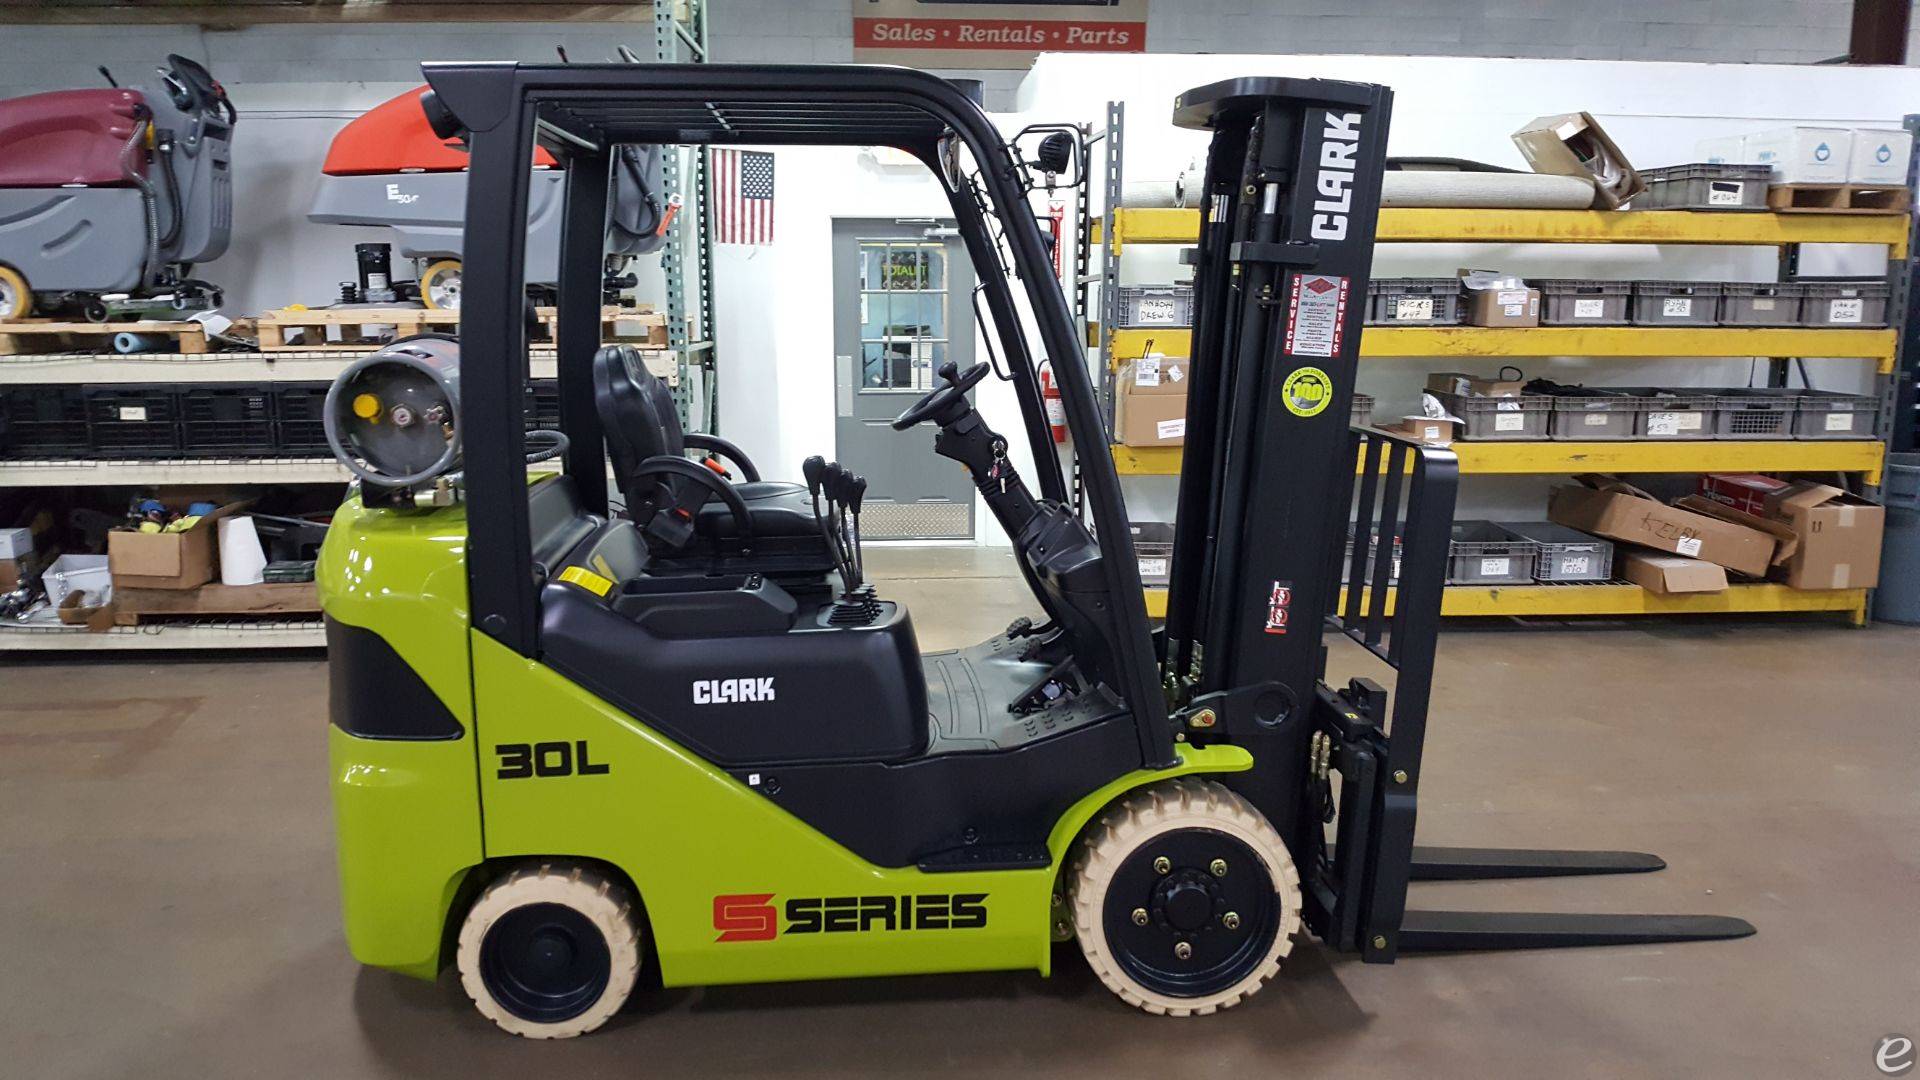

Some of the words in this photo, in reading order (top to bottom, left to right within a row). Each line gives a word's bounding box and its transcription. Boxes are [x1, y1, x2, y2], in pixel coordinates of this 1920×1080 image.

[872, 23, 936, 42] Sales
[958, 25, 1045, 44] Rentals
[1066, 27, 1129, 45] Parts
[1311, 111, 1362, 240] CLARK
[1286, 277, 1300, 350] SERVICE
[1333, 280, 1348, 353] RENTALS
[693, 677, 775, 705] CLARK
[495, 740, 610, 780] 30L
[783, 893, 990, 935] SERIES
